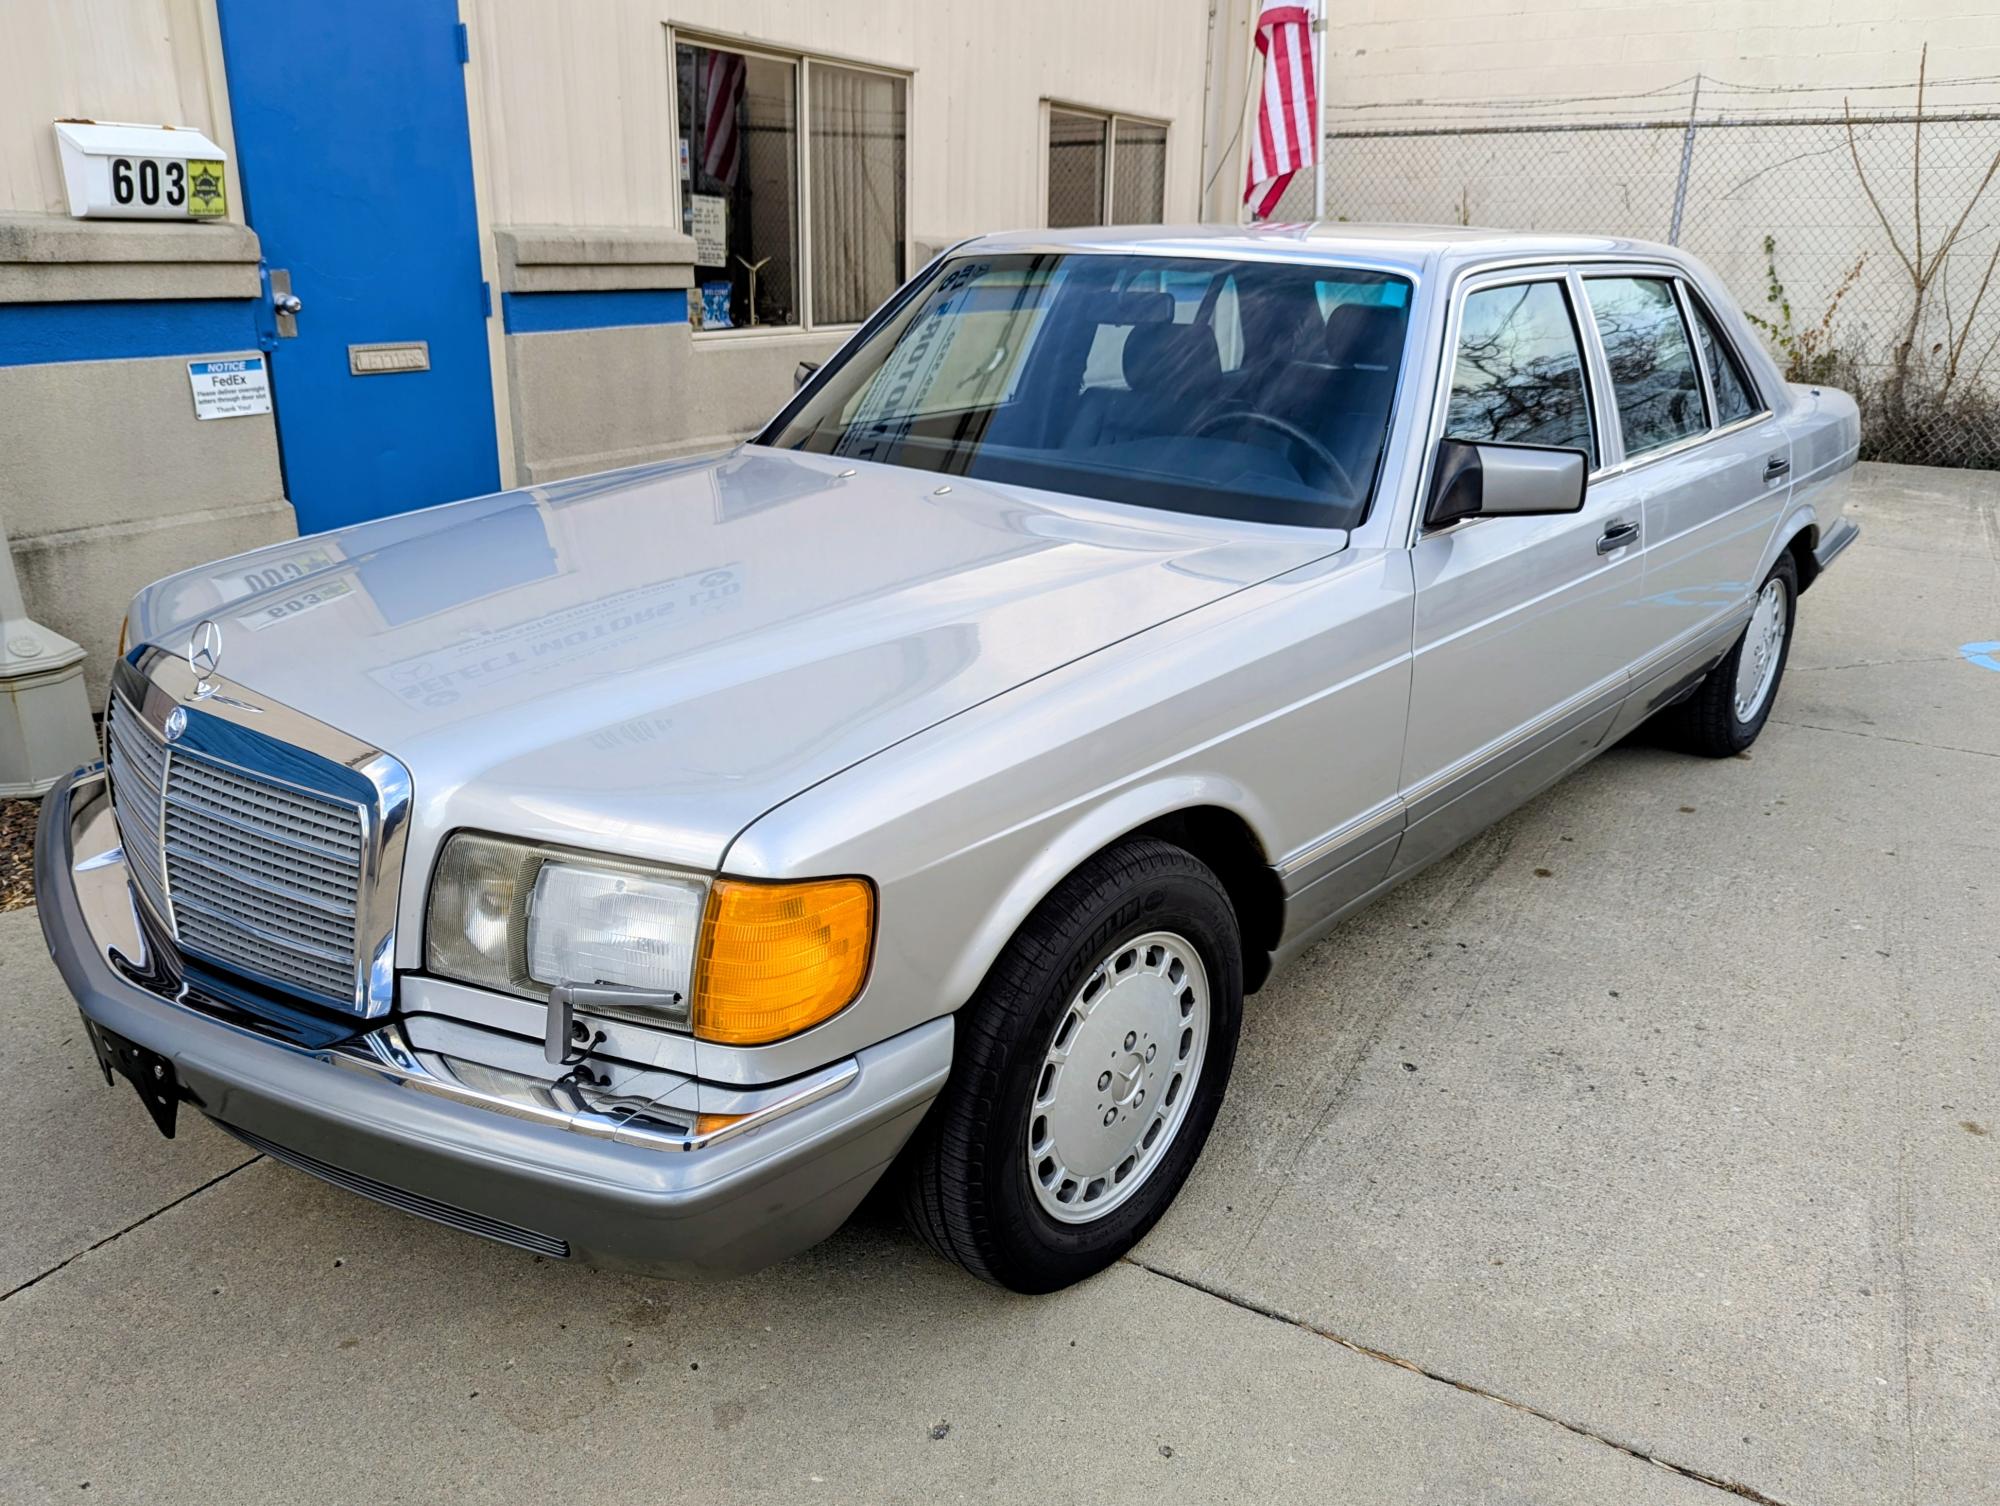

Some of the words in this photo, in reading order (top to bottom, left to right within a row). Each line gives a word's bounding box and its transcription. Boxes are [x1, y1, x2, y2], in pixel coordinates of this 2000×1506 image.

[112, 158, 186, 206] 603
[208, 362, 246, 372] NOTICE
[212, 374, 246, 387] FedEx
